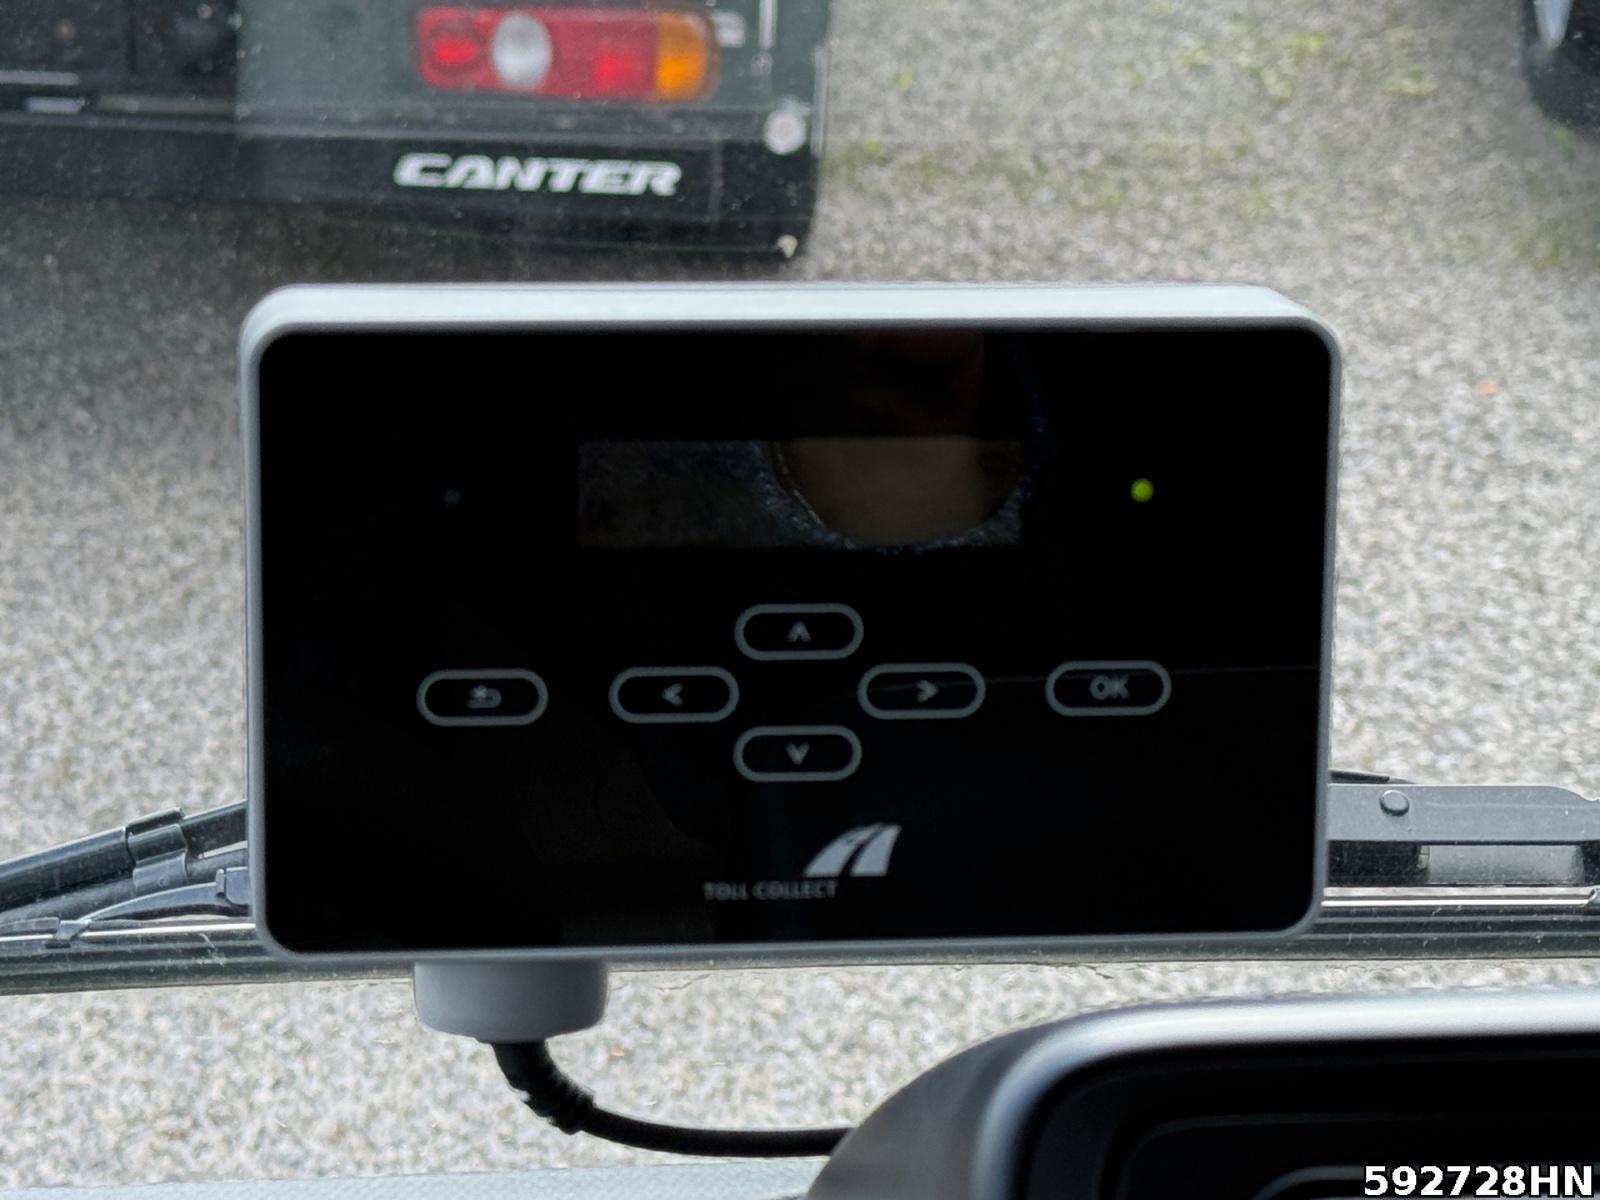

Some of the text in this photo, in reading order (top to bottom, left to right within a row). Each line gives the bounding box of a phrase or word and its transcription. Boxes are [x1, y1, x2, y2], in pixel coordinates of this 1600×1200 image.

[393, 152, 682, 196] CANTER
[1089, 674, 1130, 700] OK
[703, 879, 838, 900] TOLL COLLECT
